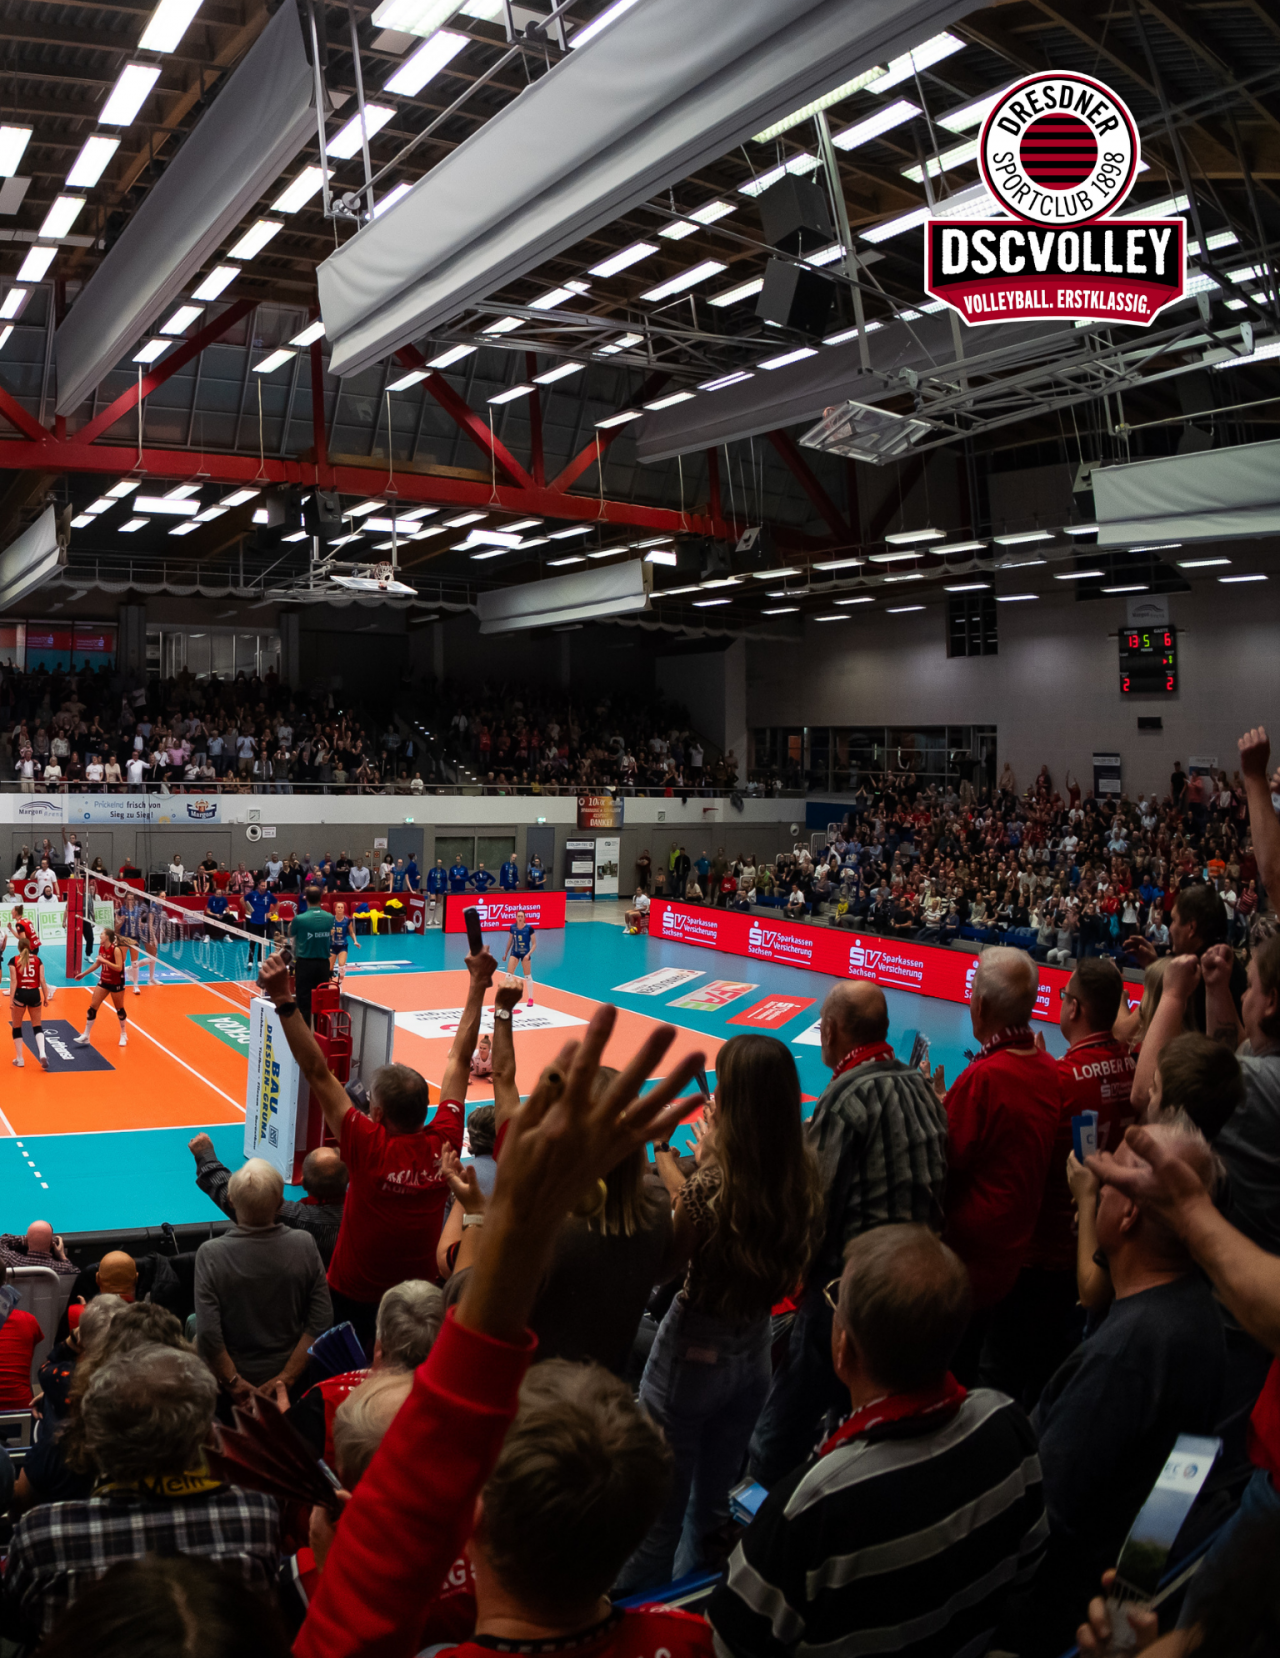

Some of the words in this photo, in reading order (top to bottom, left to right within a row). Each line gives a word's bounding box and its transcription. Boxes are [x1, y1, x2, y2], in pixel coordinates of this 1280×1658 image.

[1143, 634, 1150, 648] 5
[1164, 633, 1172, 646] 6
[1123, 678, 1130, 691] 2
[1166, 677, 1174, 690] 2
[126, 800, 146, 808] frisch
[110, 811, 124, 819] Sieg
[191, 811, 214, 819] Margon
[504, 903, 541, 911] Sparkassen
[480, 920, 500, 928] chsen
[686, 916, 718, 929] Sparkassen
[662, 928, 683, 938] Sachsen
[684, 924, 718, 939] Versicherung
[777, 933, 813, 947] Sparkassen
[748, 945, 772, 956] Sachsen
[773, 941, 812, 958] Versicherung
[882, 953, 924, 969] Sparkassen
[22, 964, 36, 978] 15
[848, 966, 876, 979] Sachsen
[877, 962, 923, 980] Versicherung
[206, 1016, 250, 1044] DEKRA
[1072, 1058, 1124, 1081] LORBER
[260, 1024, 273, 1139] DRESDEN-GRUNA
[270, 1060, 281, 1115] BAU
